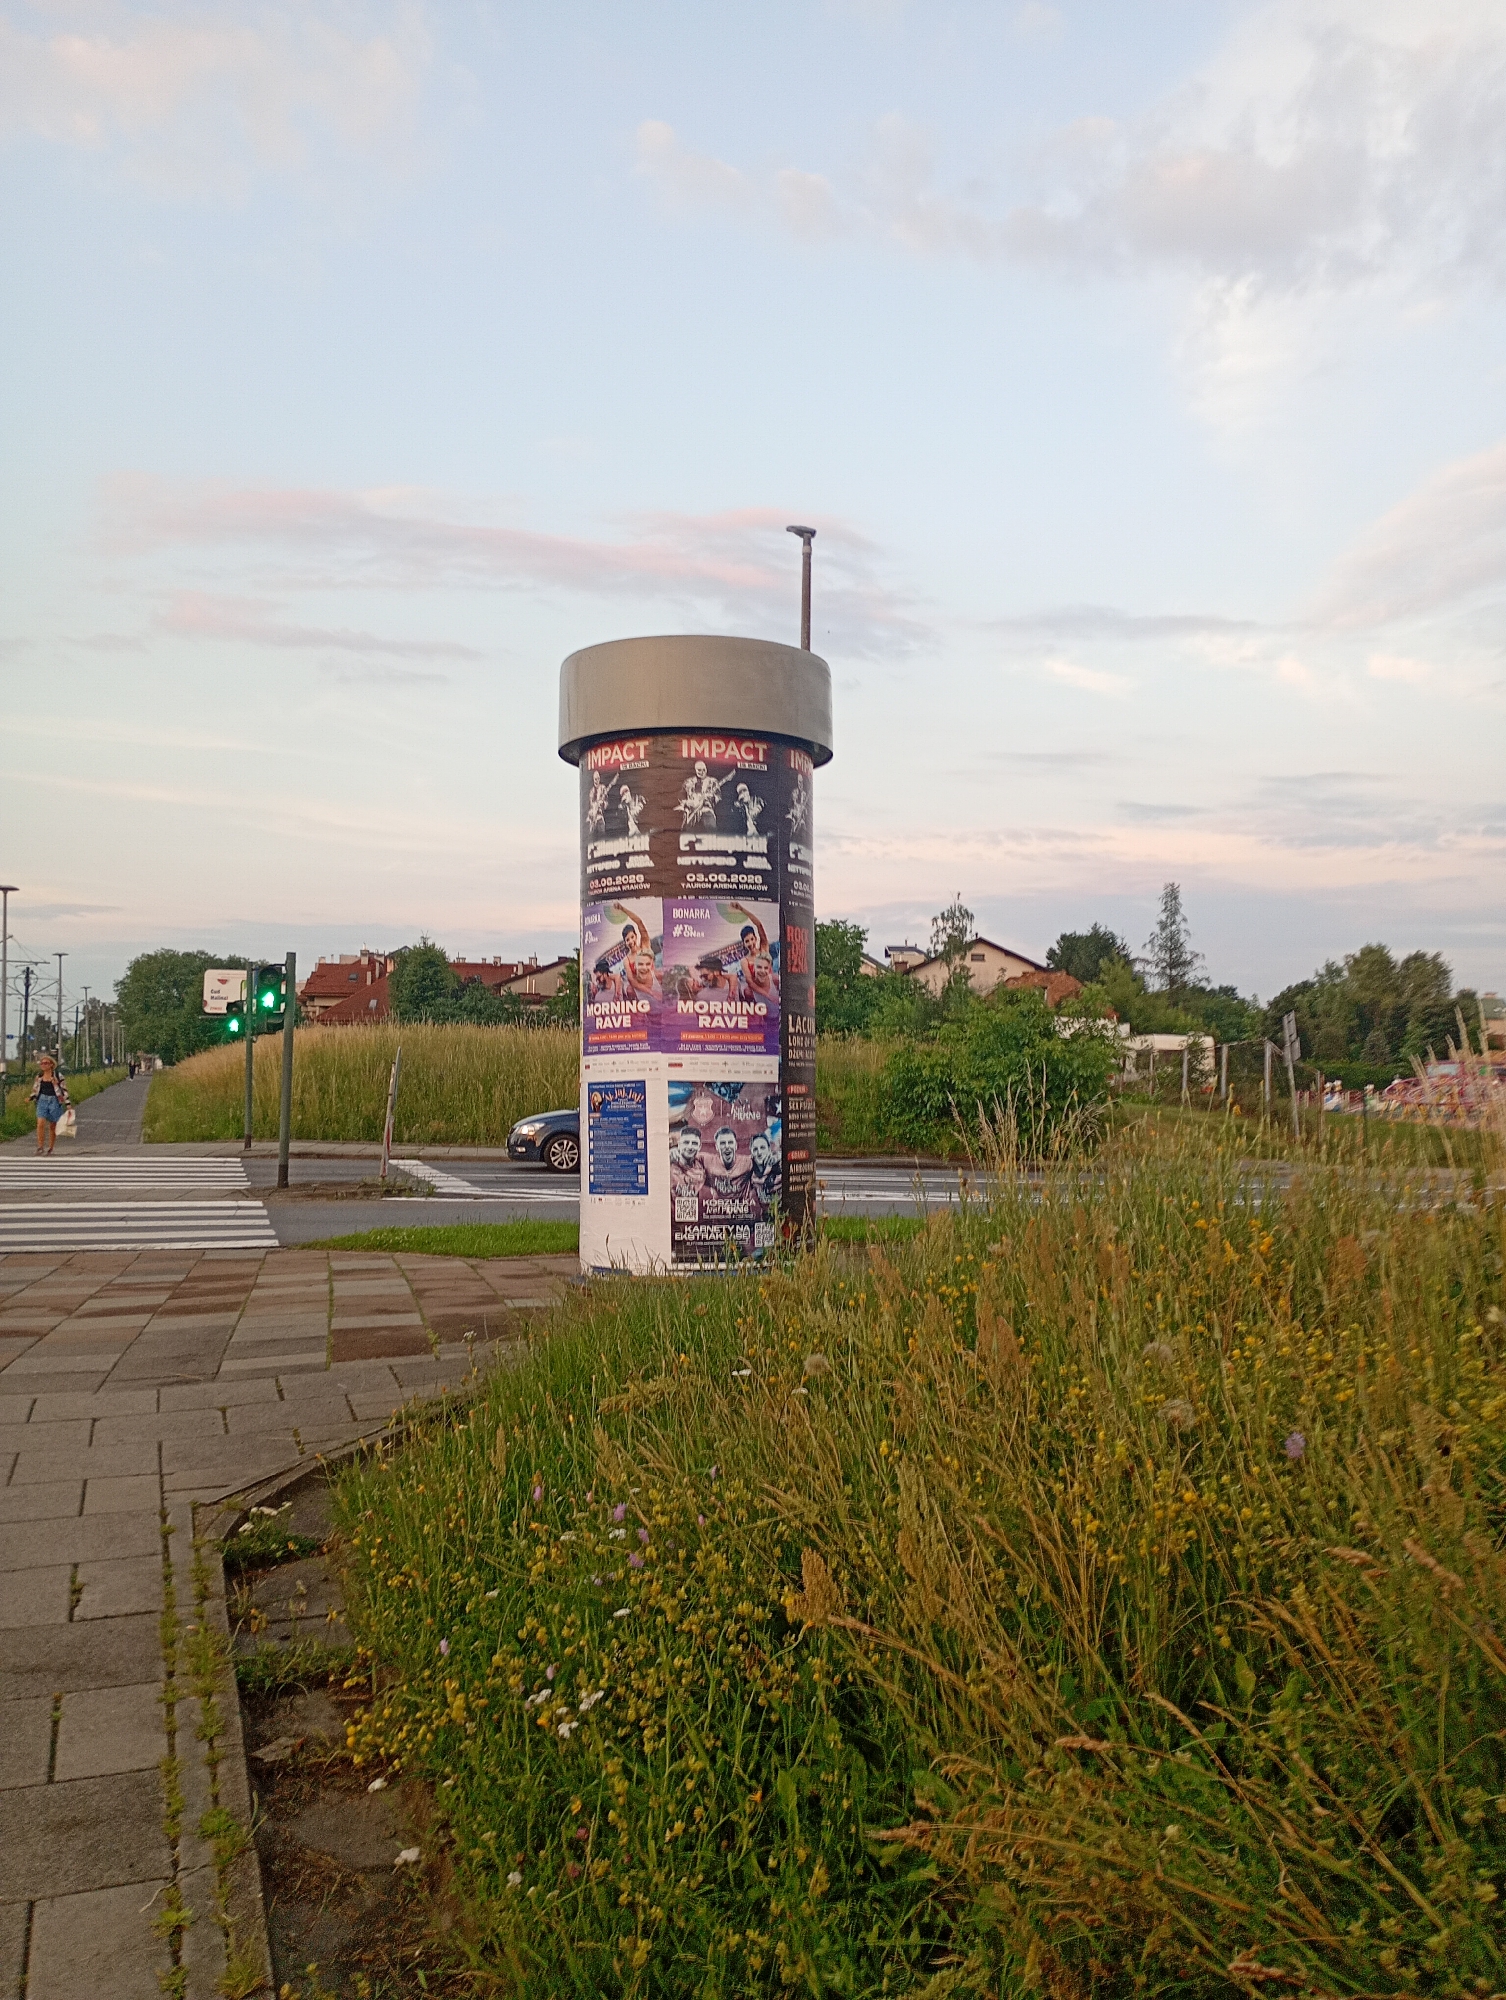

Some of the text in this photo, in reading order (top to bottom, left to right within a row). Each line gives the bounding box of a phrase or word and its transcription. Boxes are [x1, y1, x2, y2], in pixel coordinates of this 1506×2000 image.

[587, 741, 649, 770] IMPACT
[682, 739, 768, 762] IMPACT
[686, 873, 763, 884] 03.06.2026
[673, 908, 711, 919] BONARKA
[587, 1000, 650, 1017] MORNING
[677, 1000, 767, 1016] MORNING
[596, 1015, 632, 1029] RAVE
[699, 1015, 748, 1029] RAVE
[684, 1225, 750, 1234] KARNETY NA
